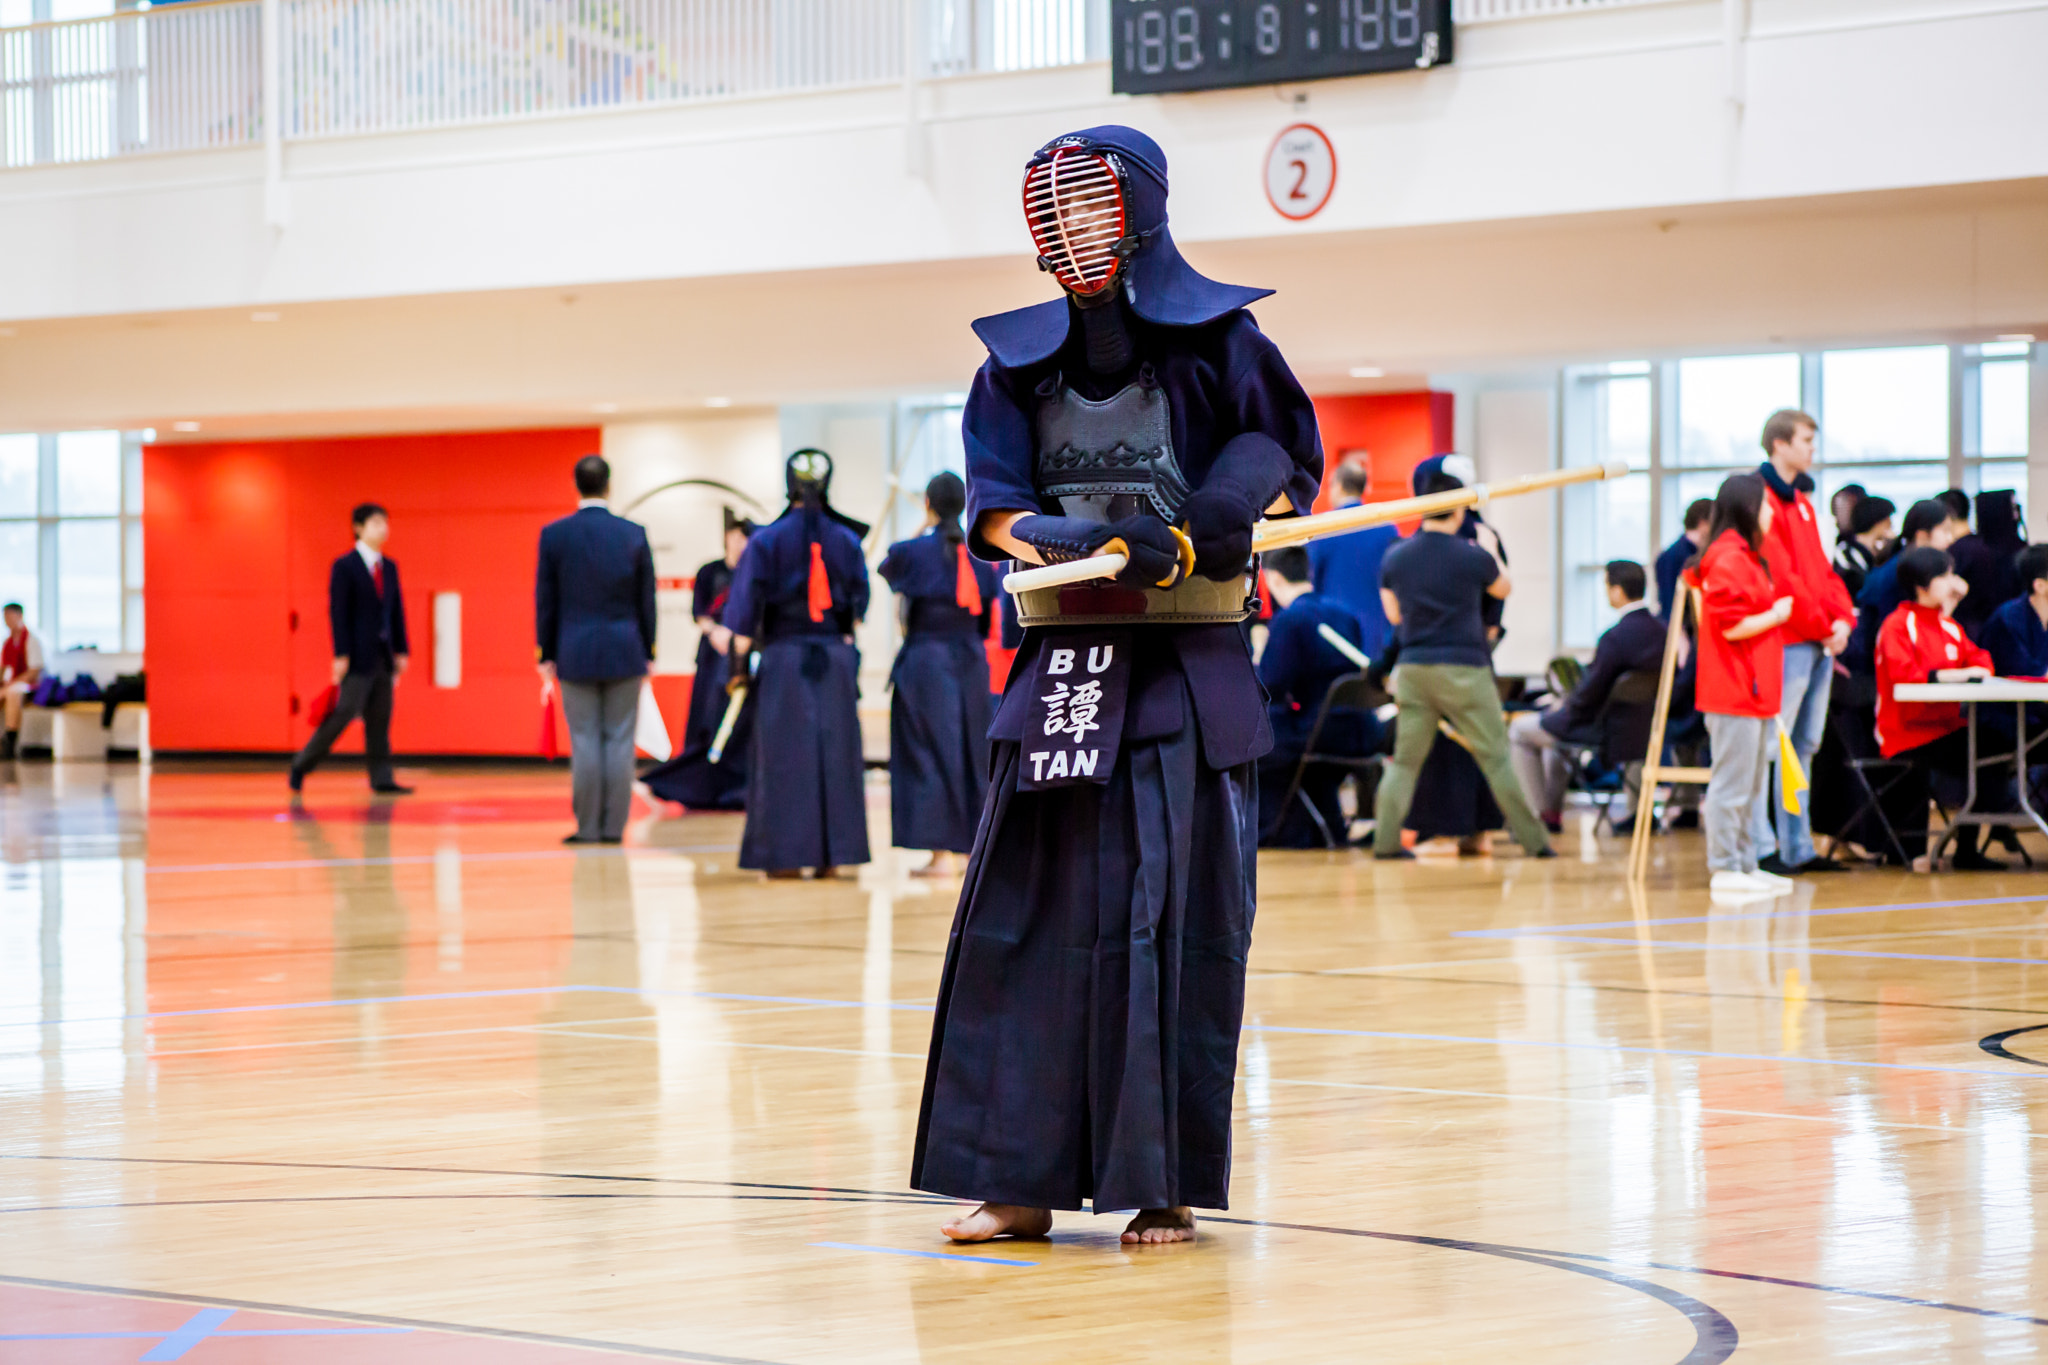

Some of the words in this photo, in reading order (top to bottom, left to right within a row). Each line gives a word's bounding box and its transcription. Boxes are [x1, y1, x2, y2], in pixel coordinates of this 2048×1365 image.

[1289, 159, 1308, 200] 2
[1041, 680, 1103, 743] 譚
[1030, 749, 1099, 781] TAN
